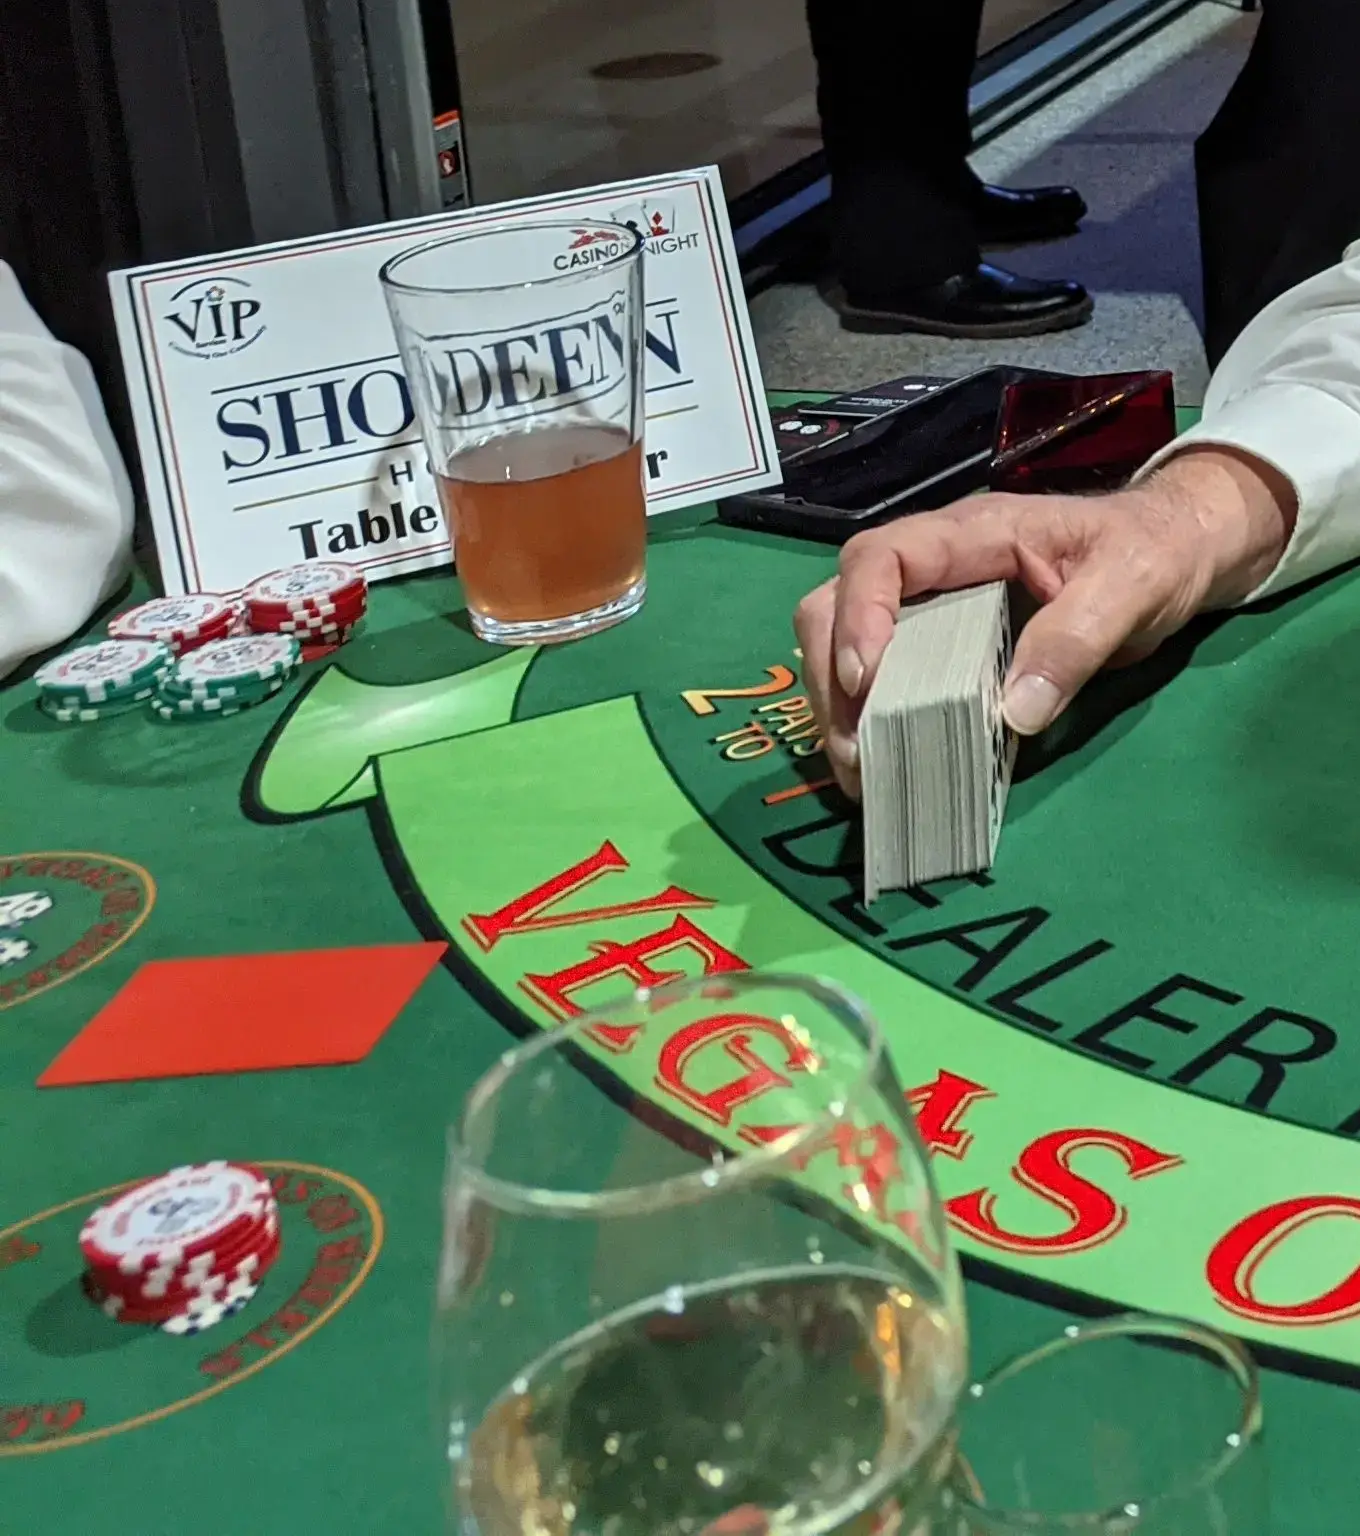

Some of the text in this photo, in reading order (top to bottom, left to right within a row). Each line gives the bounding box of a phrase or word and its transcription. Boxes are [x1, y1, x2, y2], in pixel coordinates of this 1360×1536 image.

[163, 296, 261, 344] VIP
[288, 501, 438, 561] Table
[680, 664, 797, 716] 2
[712, 720, 776, 762] TO
[460, 839, 1186, 1256] VEGAS
